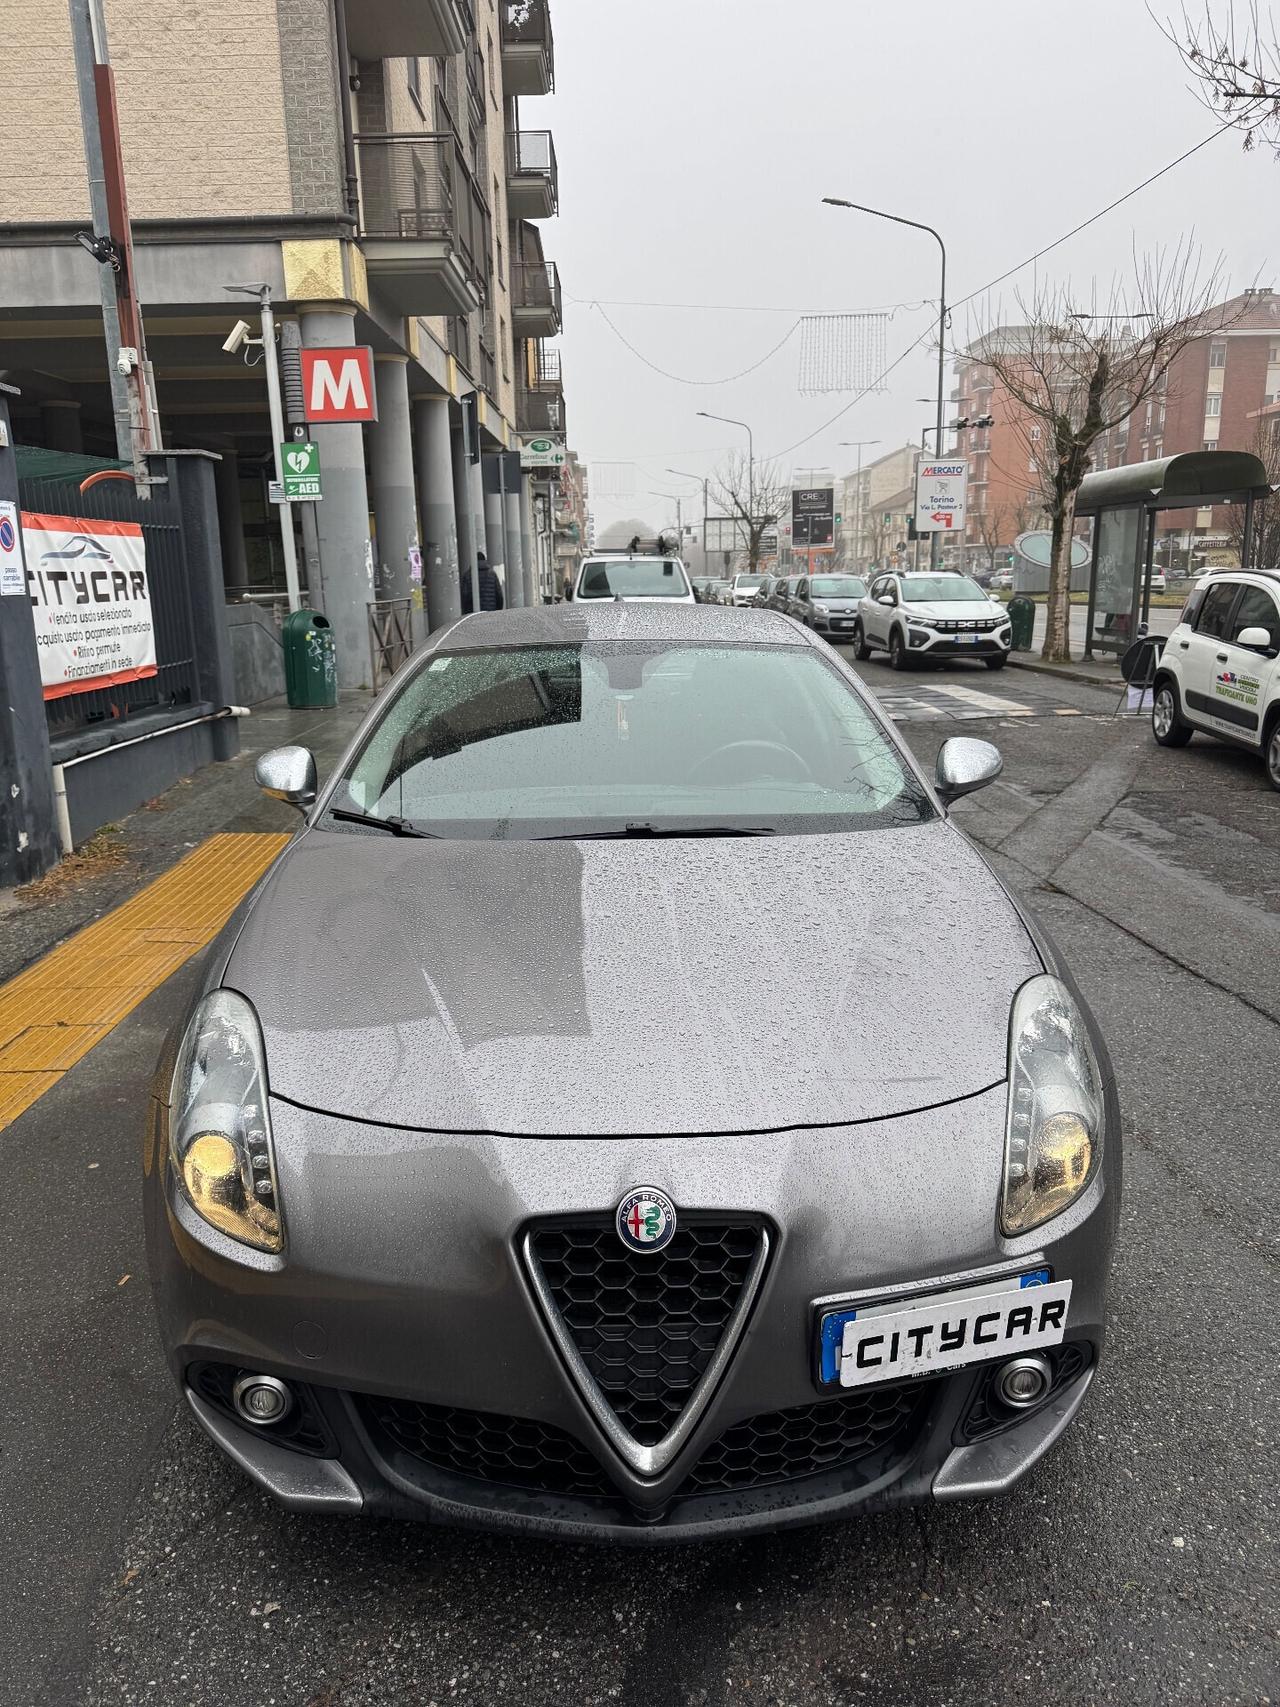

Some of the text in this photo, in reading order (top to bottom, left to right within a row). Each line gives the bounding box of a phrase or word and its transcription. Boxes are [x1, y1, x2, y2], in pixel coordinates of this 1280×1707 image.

[311, 359, 368, 410] M
[299, 483, 320, 494] AED
[930, 495, 955, 503] Torino
[80, 610, 97, 624] usato
[97, 607, 132, 622] selezionato
[65, 630, 84, 642] usato
[85, 627, 121, 643] pagamento
[120, 622, 152, 635] immediato
[77, 643, 121, 660] Ritiro permute
[67, 657, 133, 679] Finanziamenti in sede
[621, 1194, 671, 1222] ALFA ROMEO
[856, 1299, 1066, 1369] CITYCAR
